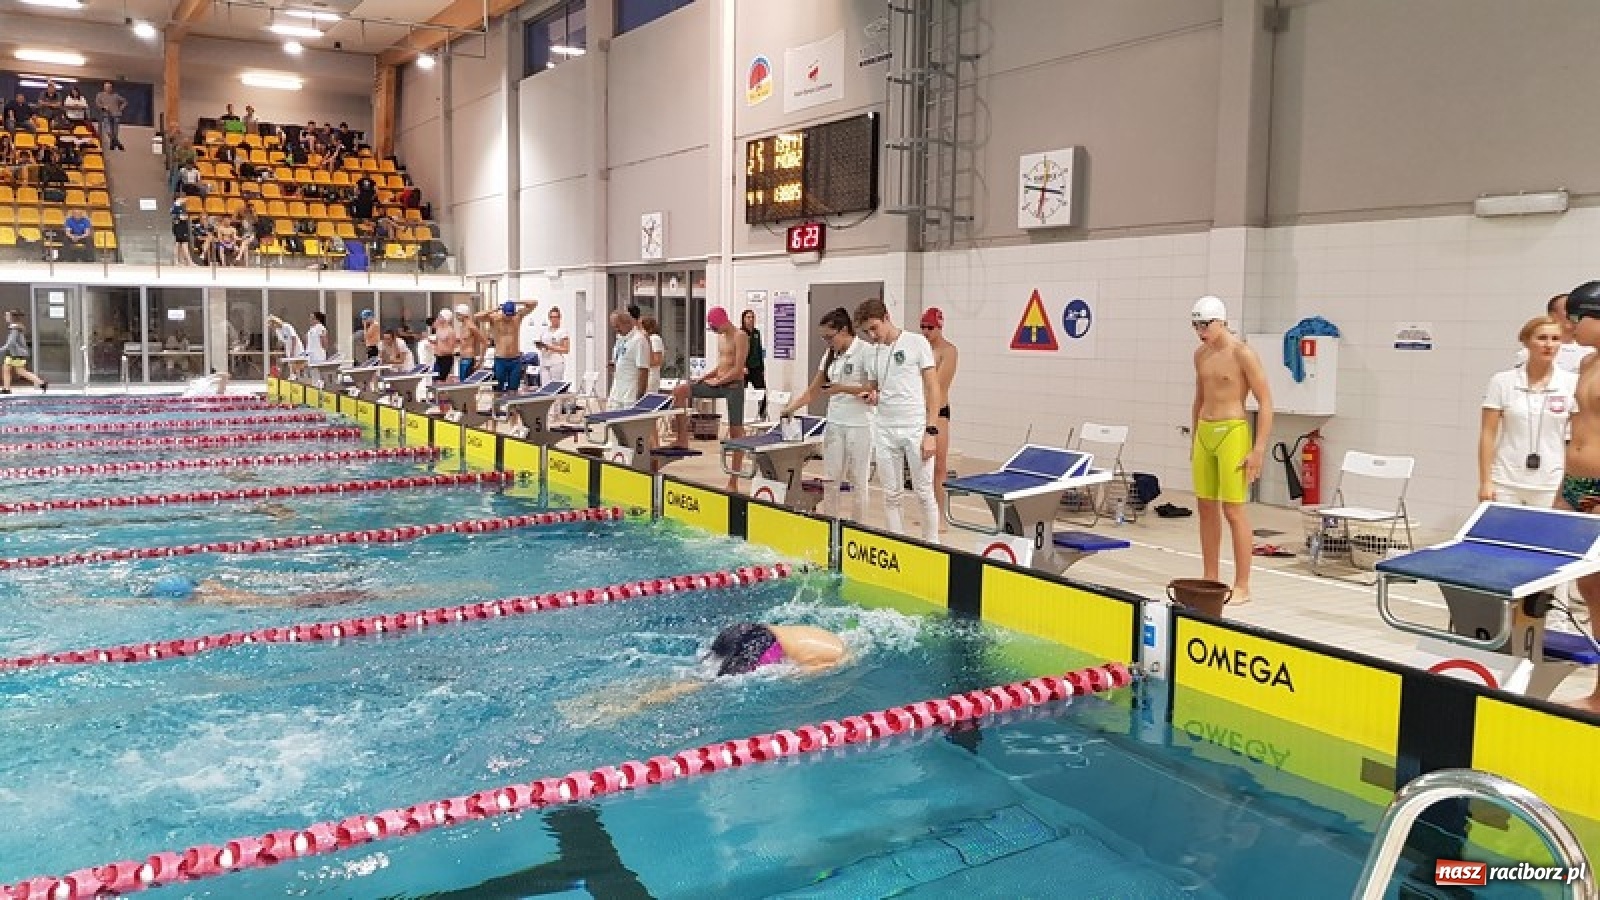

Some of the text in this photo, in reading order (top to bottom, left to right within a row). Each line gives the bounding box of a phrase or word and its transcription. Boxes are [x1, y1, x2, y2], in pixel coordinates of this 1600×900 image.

[787, 469, 795, 491] 7
[666, 489, 701, 514] OMEGA
[1035, 521, 1045, 551] 8
[846, 540, 901, 573] OMEGA
[1524, 626, 1535, 662] 9
[1187, 637, 1295, 693] OMEGA
